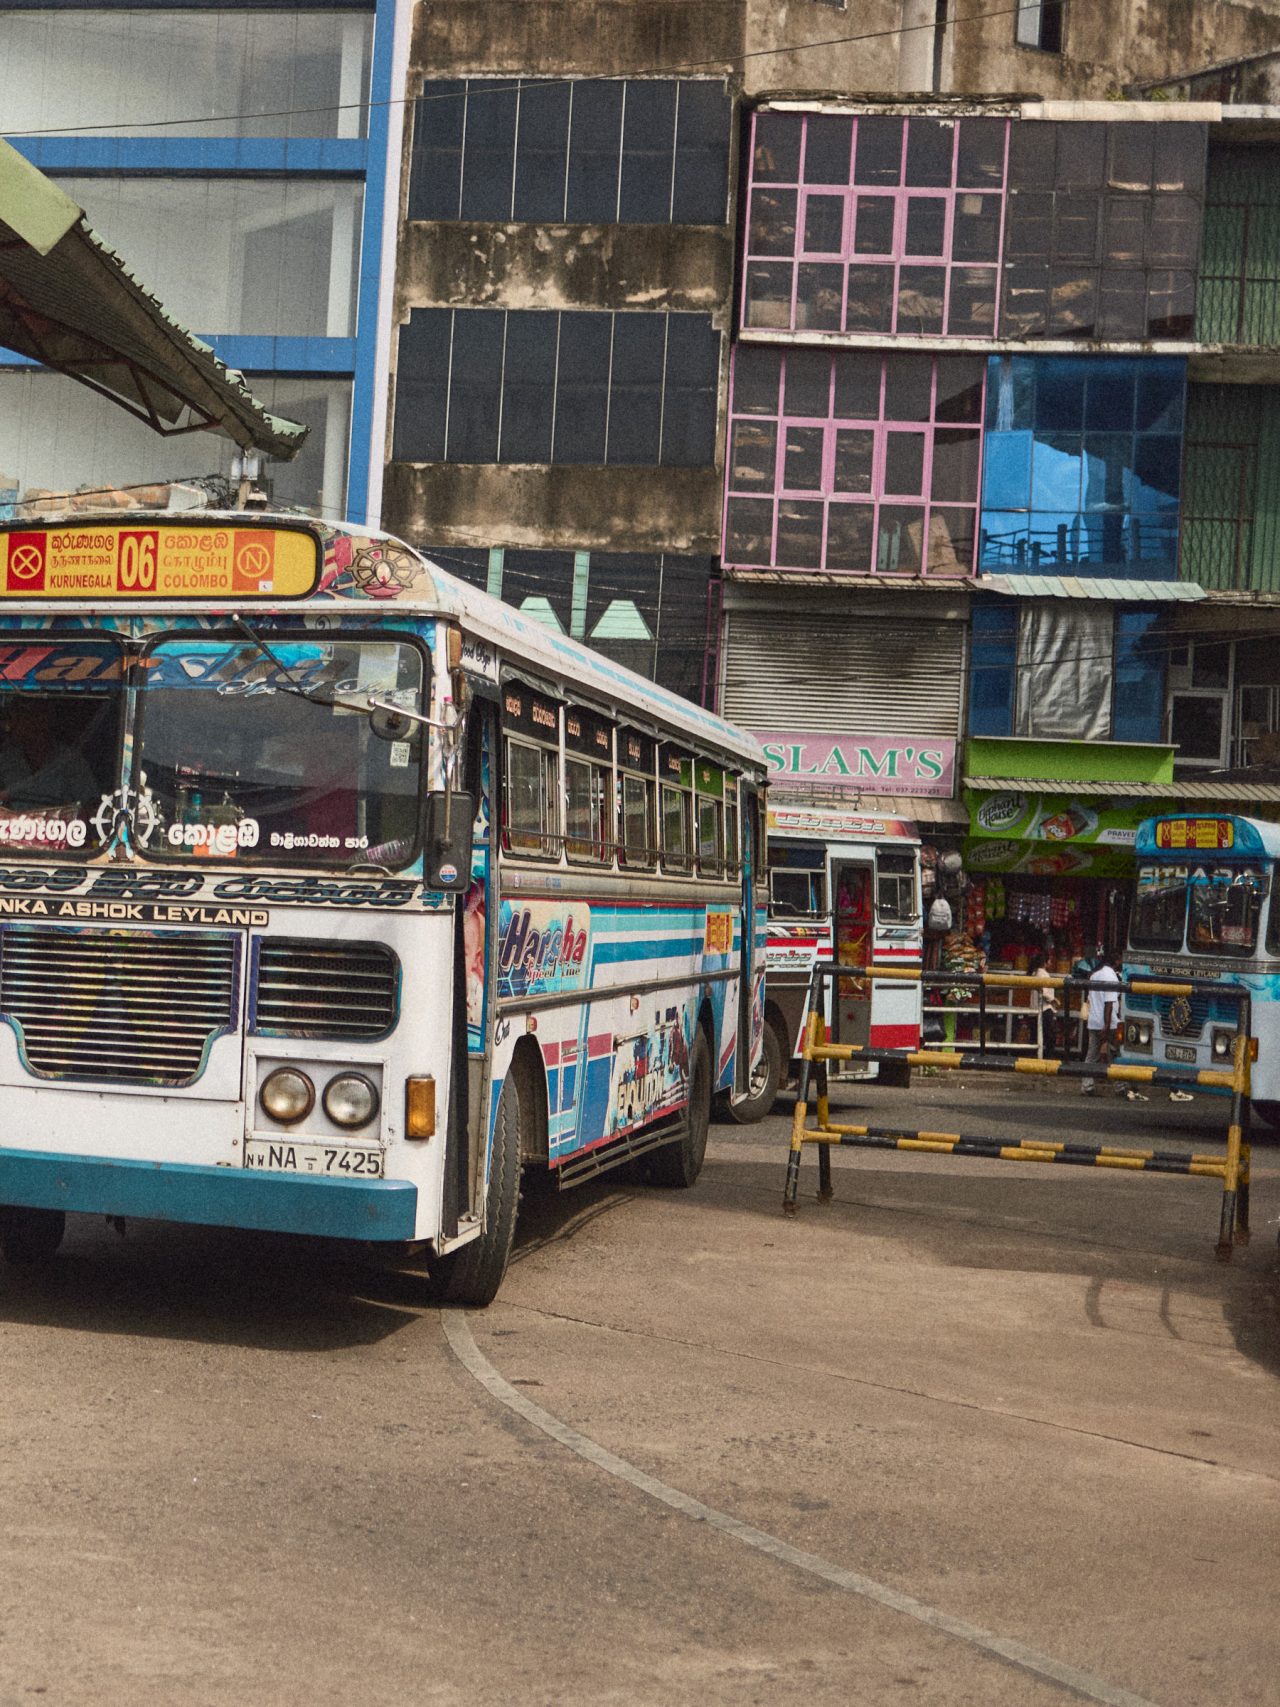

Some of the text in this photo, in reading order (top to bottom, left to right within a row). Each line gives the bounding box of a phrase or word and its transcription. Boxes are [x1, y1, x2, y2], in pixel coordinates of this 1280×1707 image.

[165, 532, 229, 551] කොළඹ
[121, 534, 155, 588] 06
[50, 574, 113, 589] KURUNEGALA
[163, 574, 228, 589] COLOMBO
[168, 818, 260, 853] කොළඹ
[344, 833, 370, 850] පාර
[59, 900, 144, 919] ASHOK
[153, 906, 269, 926] LEYLAND
[500, 908, 588, 971] Harsha
[269, 1145, 297, 1169] NA
[324, 1149, 380, 1174] 7425
